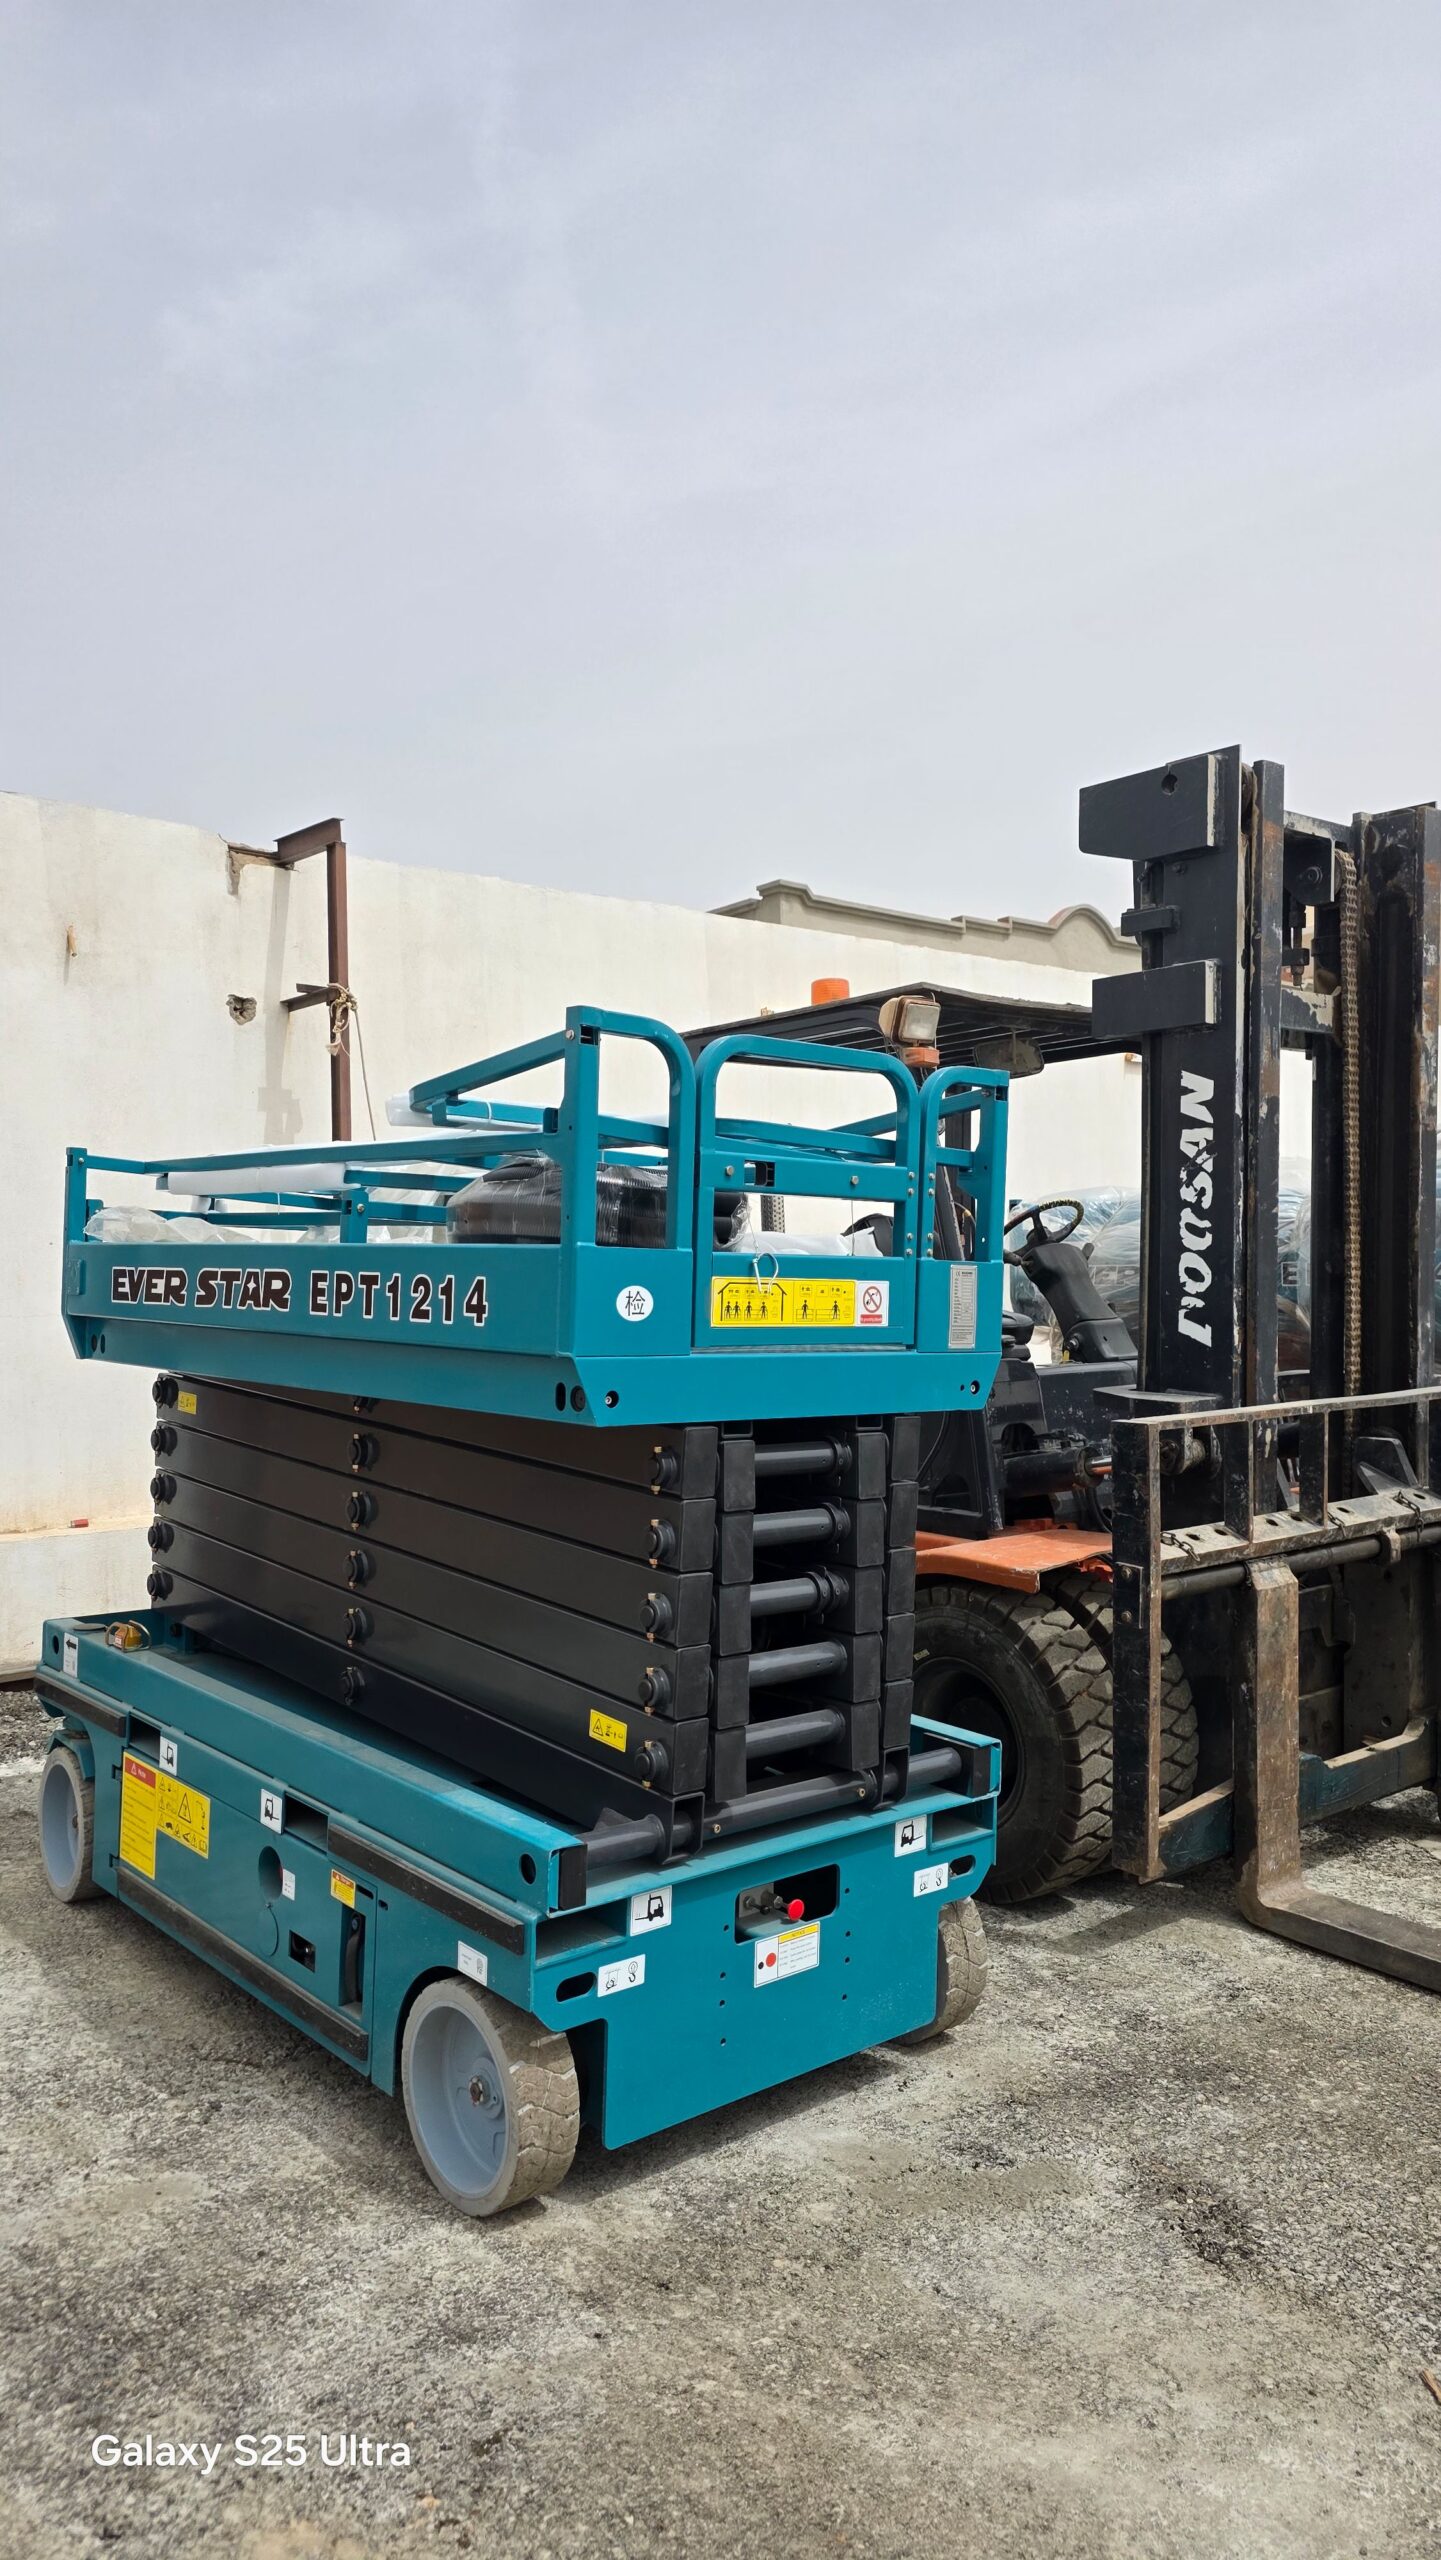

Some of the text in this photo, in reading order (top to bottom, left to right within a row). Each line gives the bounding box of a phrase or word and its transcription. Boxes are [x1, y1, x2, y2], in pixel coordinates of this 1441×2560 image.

[1178, 1070, 1214, 1347] DOOSAN
[112, 1267, 488, 1326] EVER STAR EPT1214
[625, 1290, 645, 1316] 检
